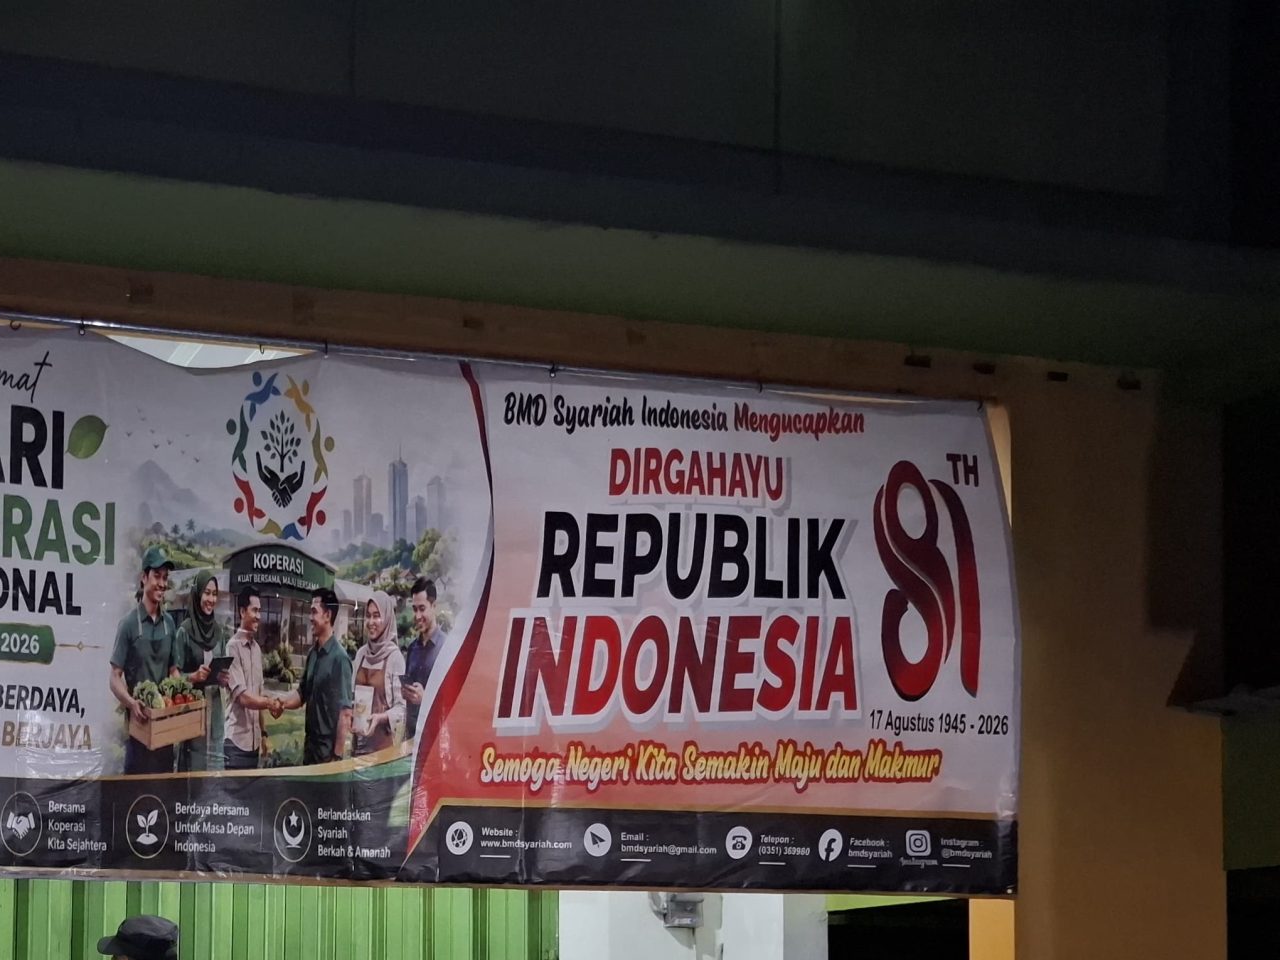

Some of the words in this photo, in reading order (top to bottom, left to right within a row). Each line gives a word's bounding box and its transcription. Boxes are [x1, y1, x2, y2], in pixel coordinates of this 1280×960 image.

[503, 392, 547, 426] BMD
[553, 394, 634, 435] Syariah
[641, 396, 728, 431] Indonesia
[733, 402, 864, 442] Mengucapkan
[609, 447, 784, 501] DIRGAHAYU
[537, 511, 846, 600] REPUBLIK
[253, 553, 304, 575] KOPERASI
[237, 573, 253, 582] KUAT
[873, 460, 981, 702] 81
[946, 453, 979, 487] TH
[0, 633, 39, 654] 2026
[497, 615, 857, 719] INDONESIA
[869, 709, 883, 730] 17
[884, 710, 935, 736] Agustus
[938, 713, 966, 734] 1945
[977, 714, 1009, 735] 2026
[1, 720, 91, 750] BERJAYA
[480, 746, 559, 792] Semoga
[565, 742, 632, 791] Negeri
[634, 745, 678, 781] Kita
[682, 744, 769, 781] Semakin
[773, 742, 822, 791] Maju
[825, 743, 860, 780] dan
[863, 742, 941, 780] Makmur
[48, 801, 86, 814] Bersama
[175, 802, 211, 818] Berdaya
[212, 803, 250, 816] Bersama
[317, 808, 371, 821] Berlandaskan
[48, 820, 86, 834] Koperasi
[174, 820, 200, 833] Untuk
[202, 822, 225, 834] Masa
[227, 822, 254, 837] Depan
[317, 826, 348, 839] Syariah
[481, 827, 513, 837] Website
[621, 832, 644, 842] Email
[760, 834, 790, 845] Telepon
[850, 837, 885, 847] Facebook
[47, 838, 65, 851] Kita
[67, 838, 107, 852] Sejahtera
[174, 840, 216, 853] Indonesia
[317, 845, 345, 857] Berkah
[347, 847, 354, 857] &
[355, 847, 391, 858] Amanah
[480, 839, 572, 850] www.bmdsyariah.com
[621, 843, 717, 855] bmdsyariah@gmail.com
[848, 848, 893, 859] bmdsyariah
